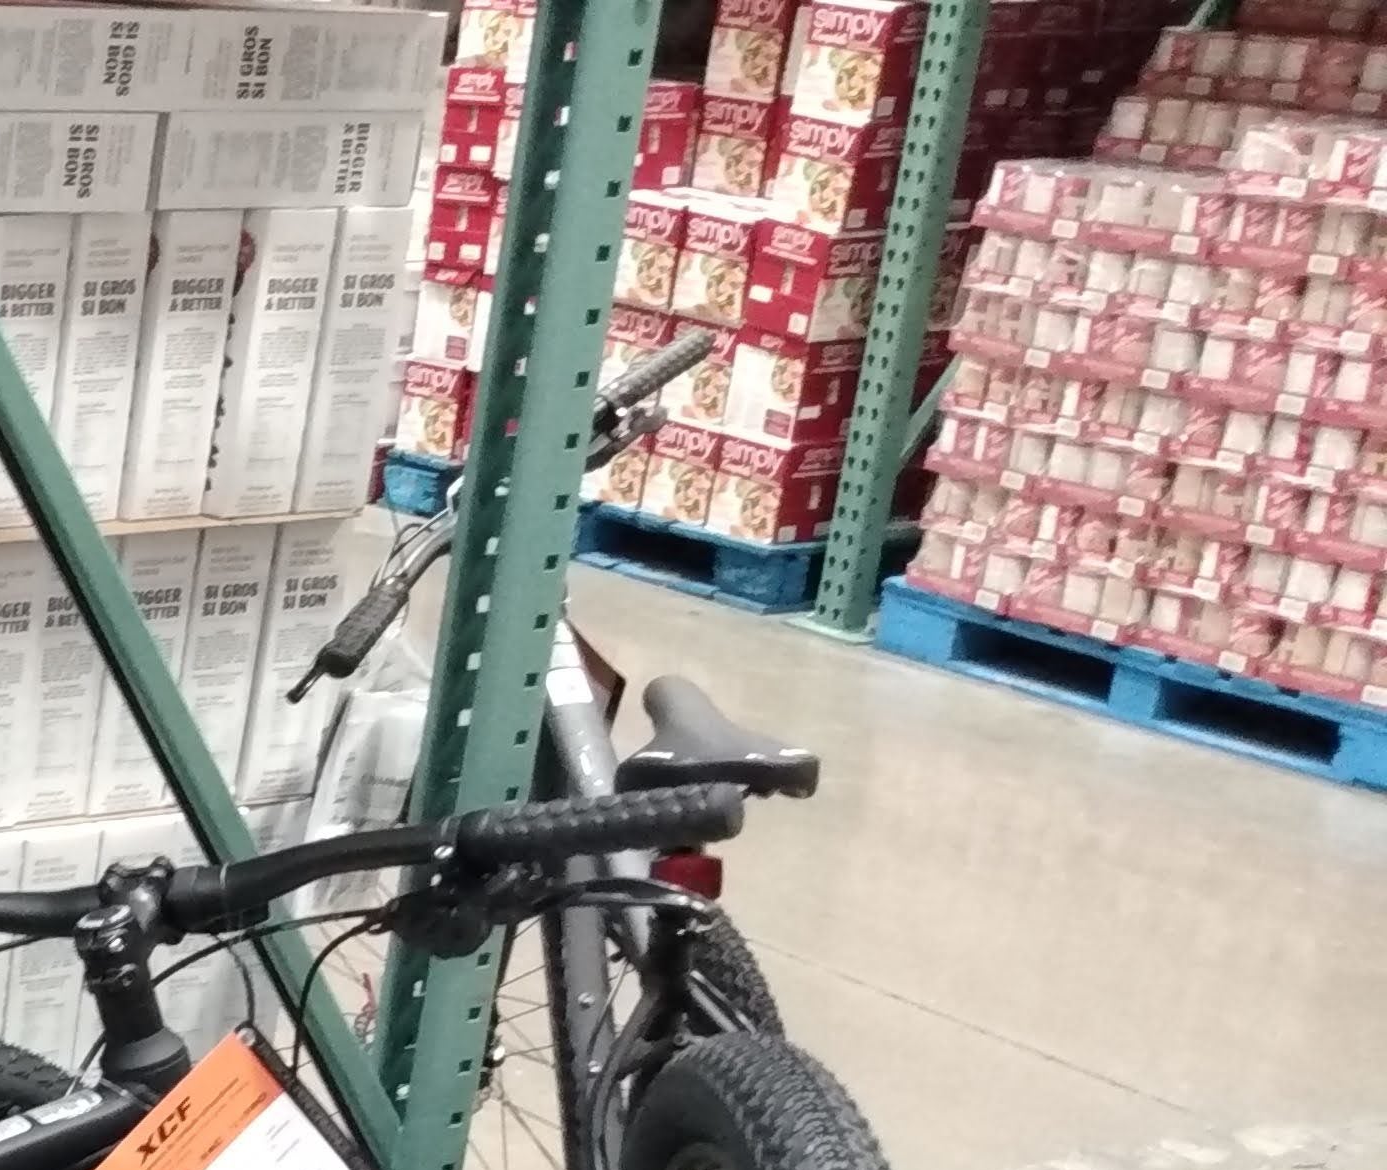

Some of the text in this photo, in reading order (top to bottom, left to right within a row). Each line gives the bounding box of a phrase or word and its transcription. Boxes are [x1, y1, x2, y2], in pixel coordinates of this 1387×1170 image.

[812, 5, 887, 43] simply
[102, 21, 124, 84] SI BON
[116, 21, 141, 97] SI GROS
[239, 25, 260, 77] GROS
[254, 38, 274, 77] BON
[703, 100, 769, 136] simply
[63, 124, 84, 188] SI BON
[789, 119, 859, 158] simply
[77, 124, 100, 200] SI GROS
[690, 213, 751, 251] simply
[0, 282, 56, 301] BIGGER
[100, 279, 137, 297] GROS
[171, 278, 225, 296] BIGGER
[267, 278, 319, 295] BIGGER
[360, 273, 395, 290] GROS
[10, 302, 56, 318] BETTER
[180, 298, 223, 312] BETTER
[275, 297, 317, 311] BETTER
[611, 306, 669, 348] simply
[404, 363, 461, 396] simply
[657, 423, 721, 464] simply
[723, 437, 785, 478] simply
[141, 604, 181, 620] ETTER
[135, 1096, 193, 1165] XCF
